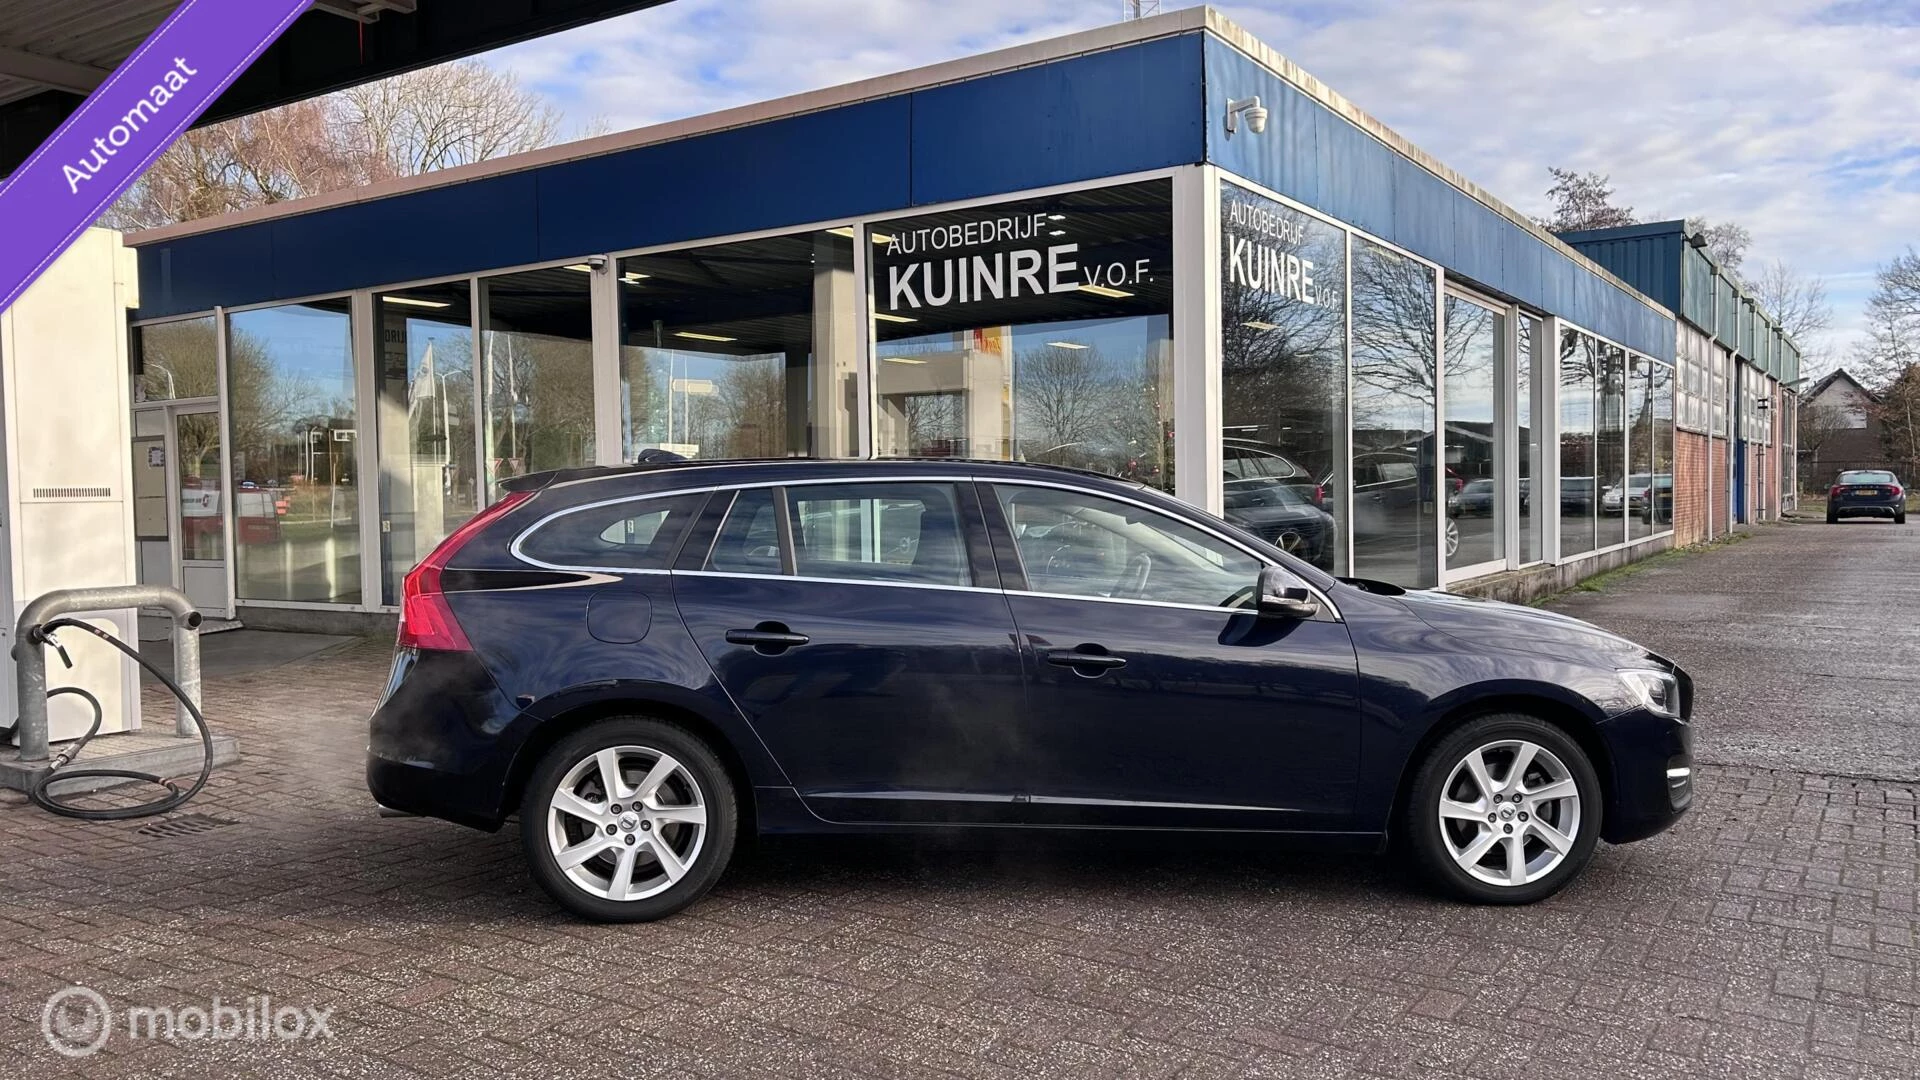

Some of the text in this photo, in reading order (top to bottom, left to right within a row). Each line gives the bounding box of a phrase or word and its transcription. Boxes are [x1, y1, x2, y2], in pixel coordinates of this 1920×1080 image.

[887, 213, 1047, 256] AUTOBEDRIJF
[1230, 200, 1304, 245] AUTOBEDRIJF
[889, 243, 1154, 311] KUINRE V.O.F.
[1229, 234, 1315, 304] KUINRE
